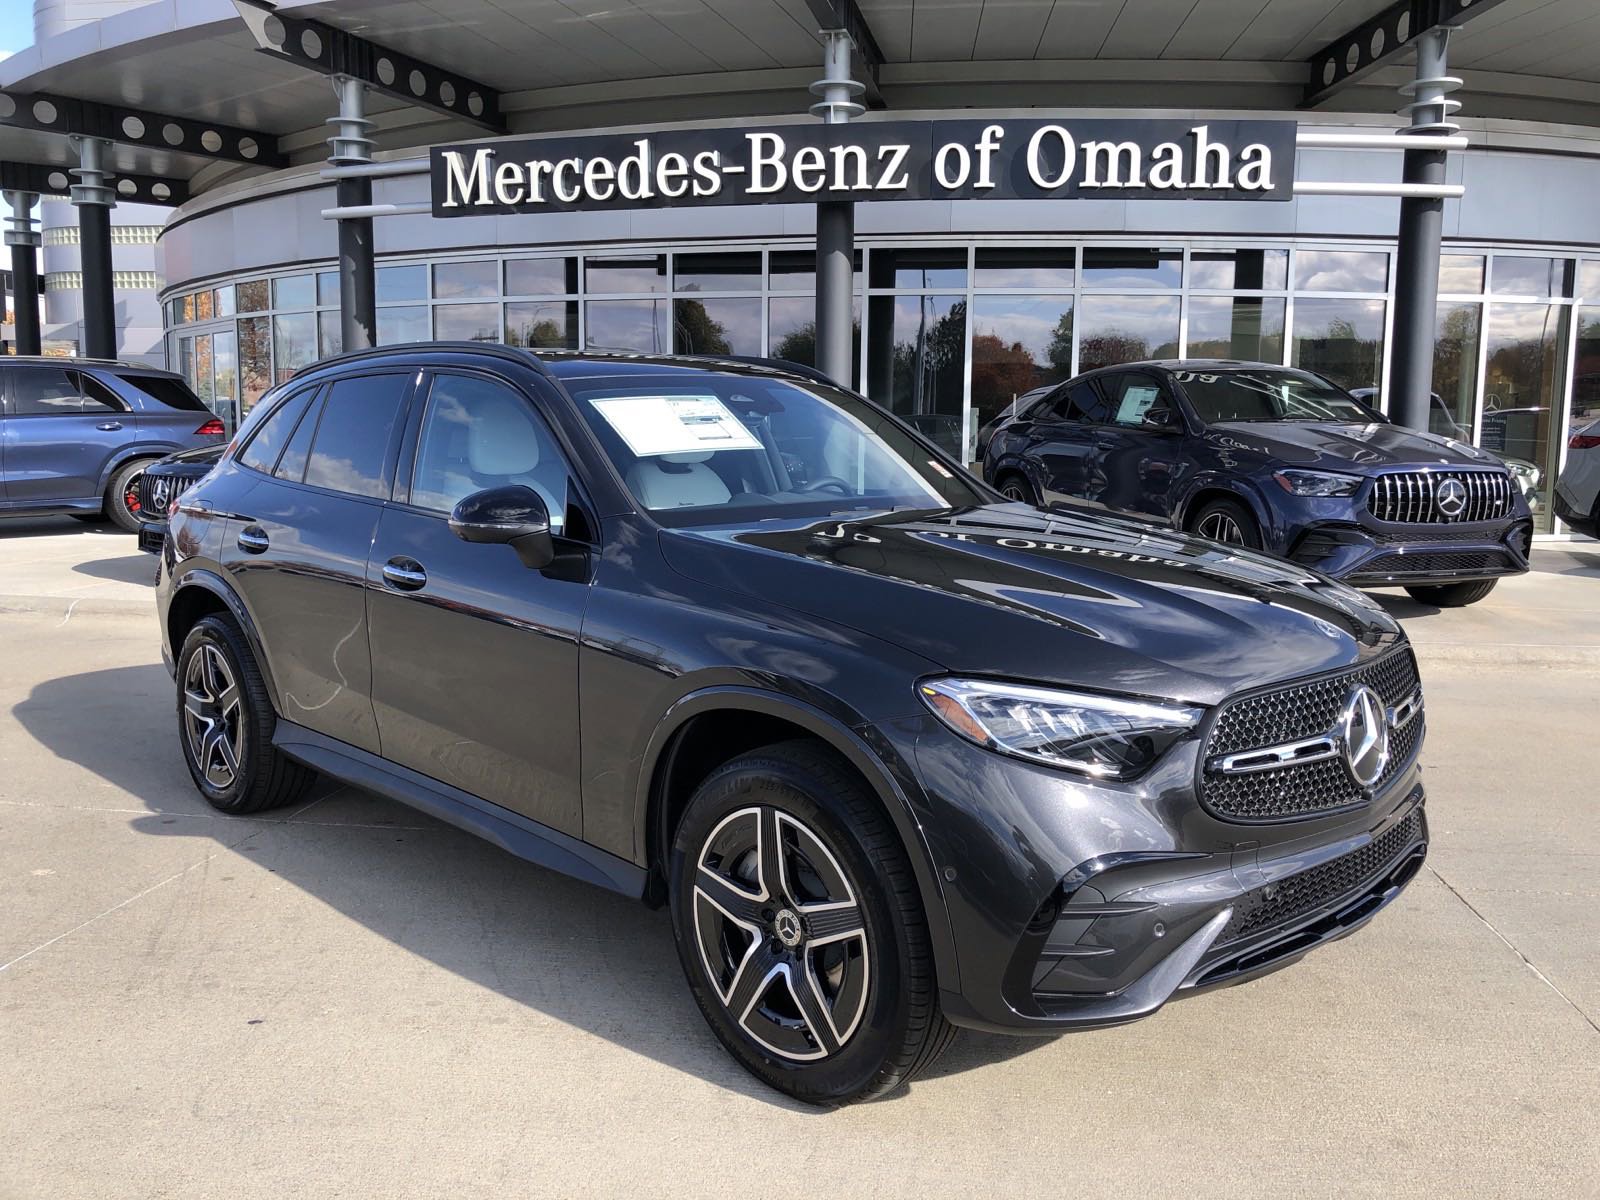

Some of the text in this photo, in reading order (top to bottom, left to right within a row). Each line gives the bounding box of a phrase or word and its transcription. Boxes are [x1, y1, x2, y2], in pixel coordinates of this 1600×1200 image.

[441, 124, 1276, 207] Mercedes-Benz of Omaha
